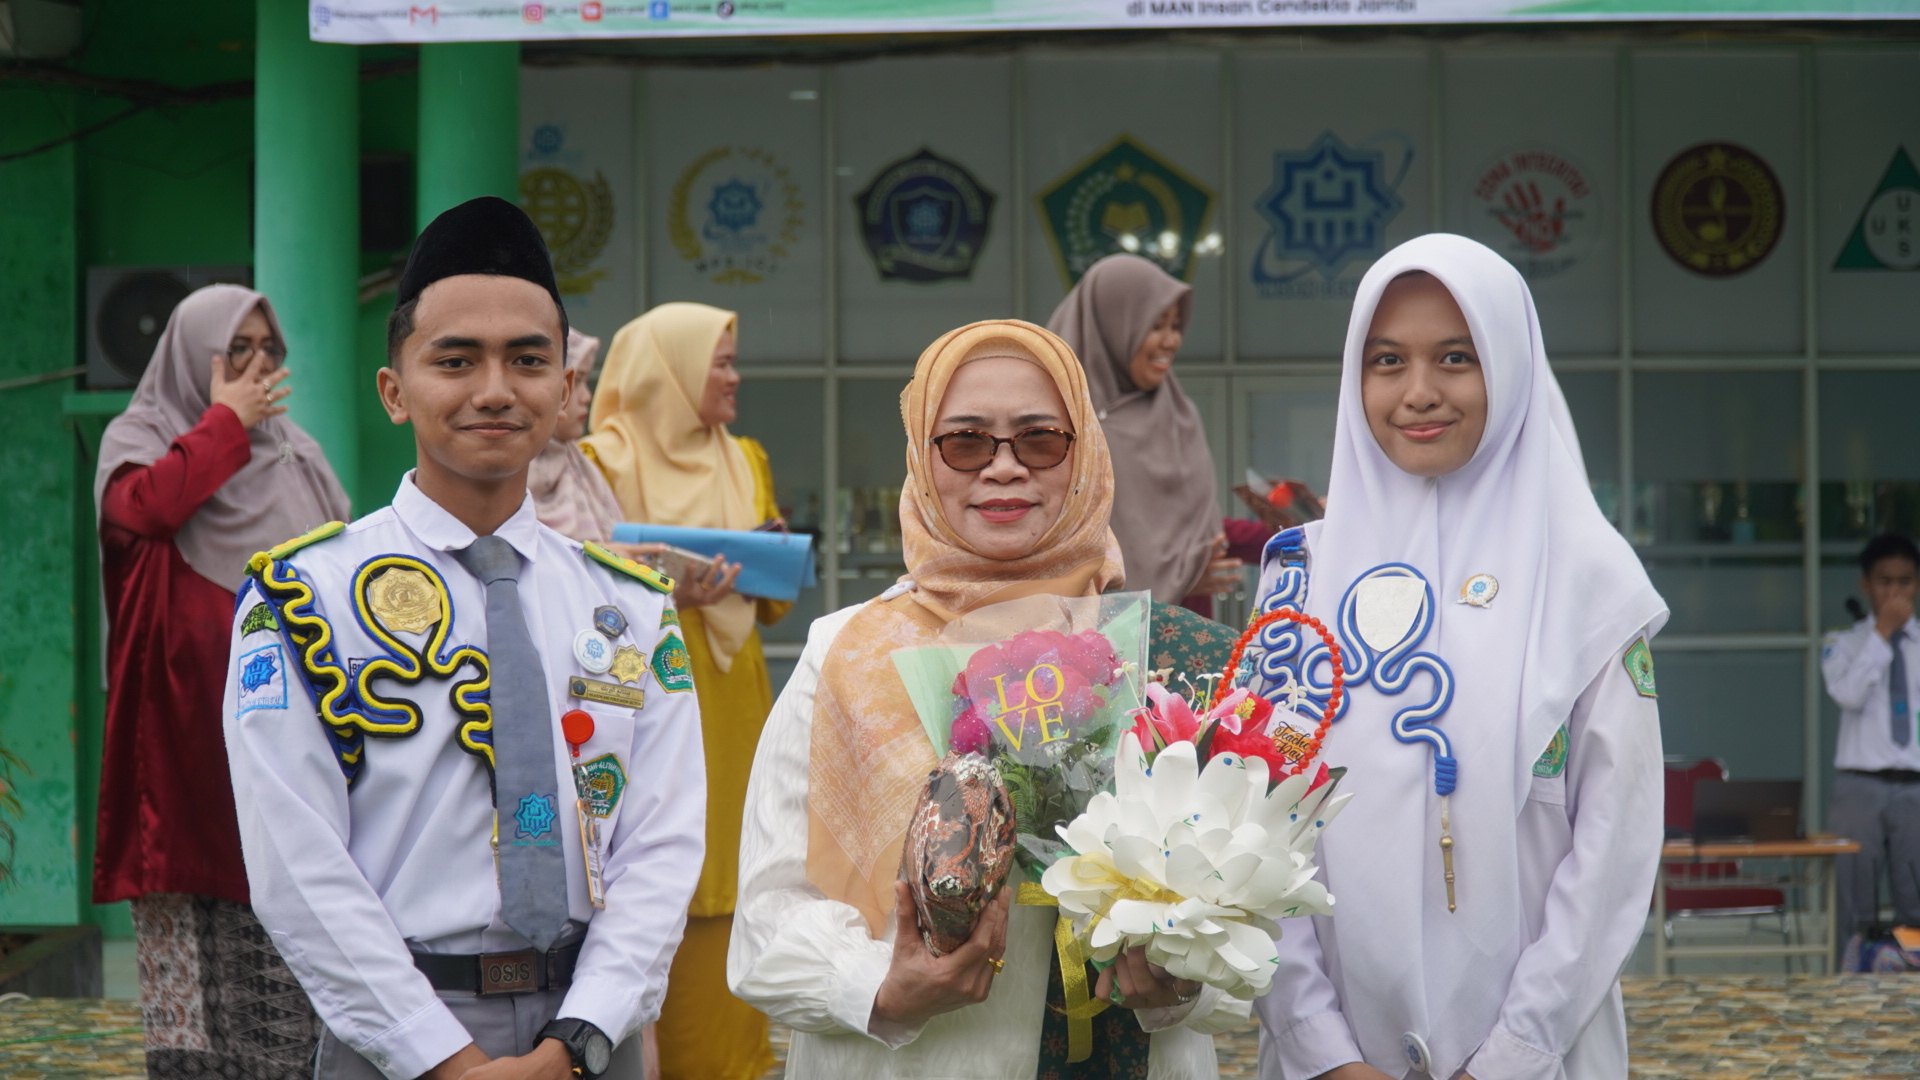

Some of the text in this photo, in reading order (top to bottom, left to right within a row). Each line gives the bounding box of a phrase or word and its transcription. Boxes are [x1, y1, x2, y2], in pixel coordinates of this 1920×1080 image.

[1151, 1, 1194, 15] MAN
[1199, 0, 1252, 15] Insan
[488, 961, 532, 985] OSIS
